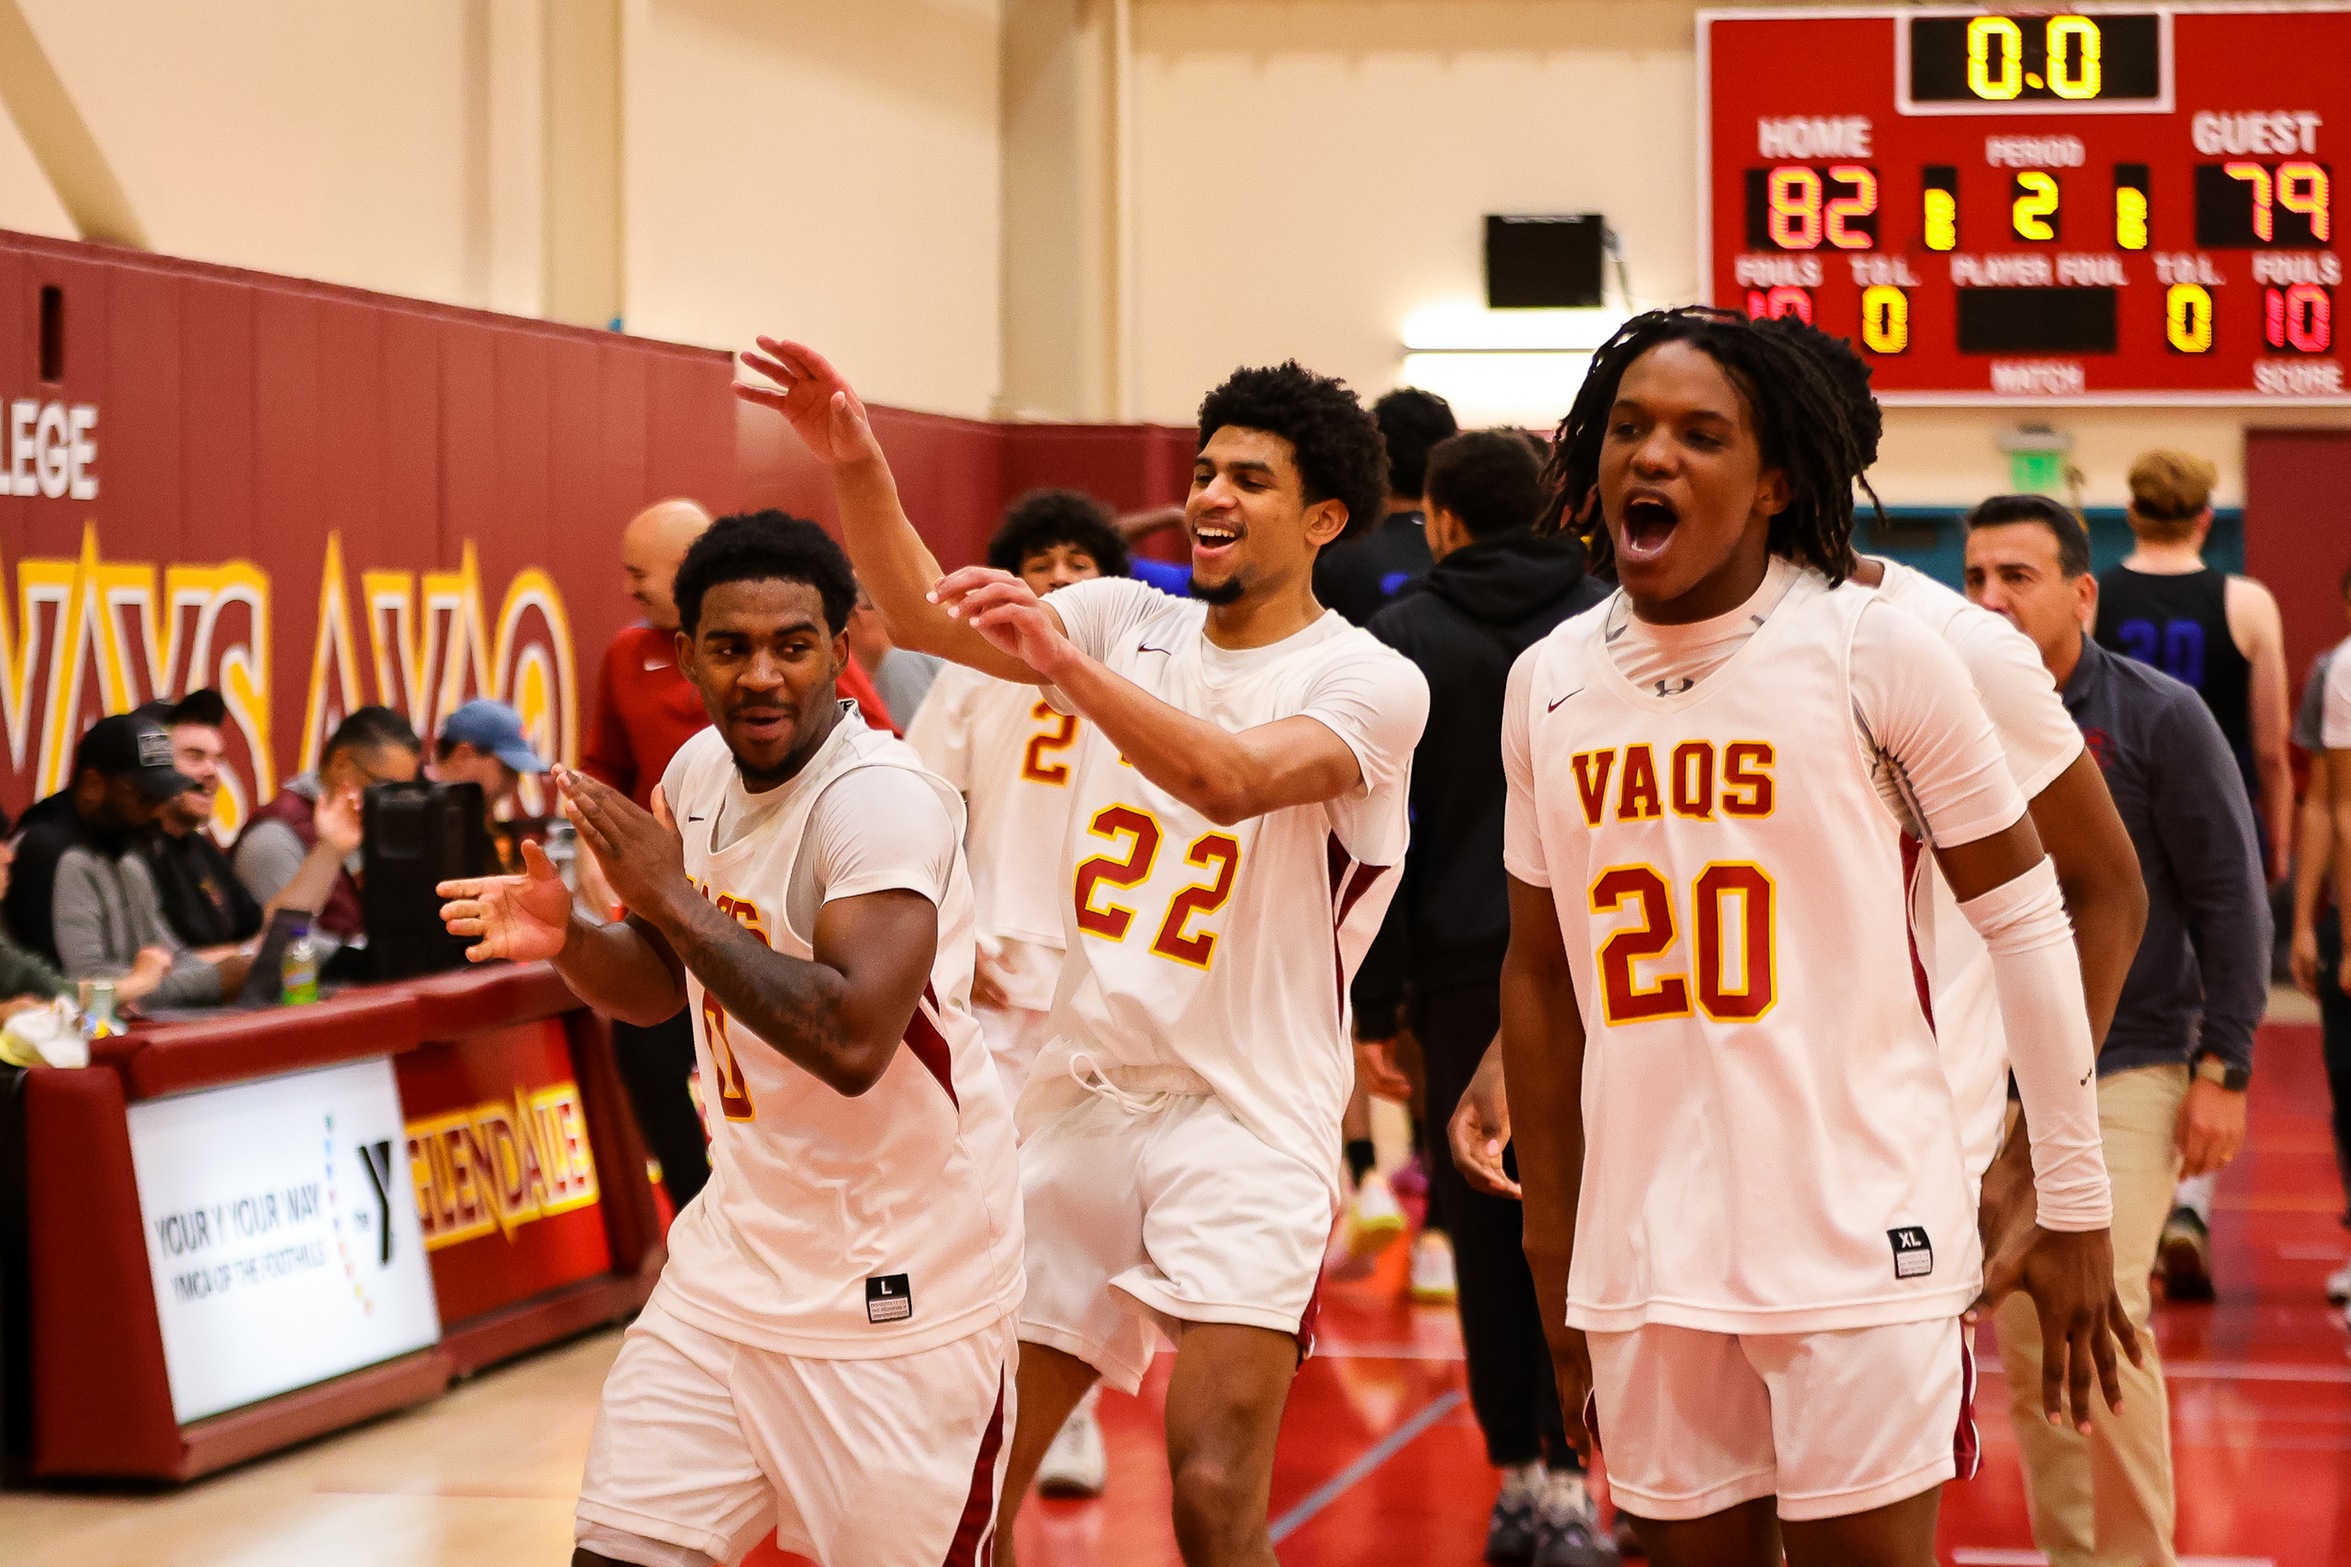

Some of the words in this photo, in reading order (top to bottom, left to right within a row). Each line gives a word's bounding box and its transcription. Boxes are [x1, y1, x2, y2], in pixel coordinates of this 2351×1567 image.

[1967, 15, 2101, 99] 0.0
[1757, 117, 1873, 158] HOME
[1985, 135, 2086, 167] PERIOD
[2191, 111, 2323, 155] GUEST
[1768, 165, 1878, 249] 82
[2013, 172, 2058, 240] 2
[2224, 161, 2329, 242] 79
[1735, 253, 1823, 287] FOULS
[1951, 254, 2052, 287] PLAYER
[2057, 254, 2131, 287] FOUL
[2252, 252, 2343, 285] FOULS
[1862, 284, 1908, 353] 0
[2167, 283, 2212, 353] 0
[2266, 283, 2331, 352] 10
[1990, 360, 2085, 395] MATCH
[2253, 359, 2345, 394] SCORE
[1570, 739, 1776, 827] VAQS
[1074, 802, 1240, 971] 22
[1588, 860, 1778, 1027] 20
[154, 1210, 211, 1258] YOUR
[228, 1193, 279, 1237] YOUR
[1898, 1231, 1922, 1249] XL
[880, 1280, 893, 1295] L
